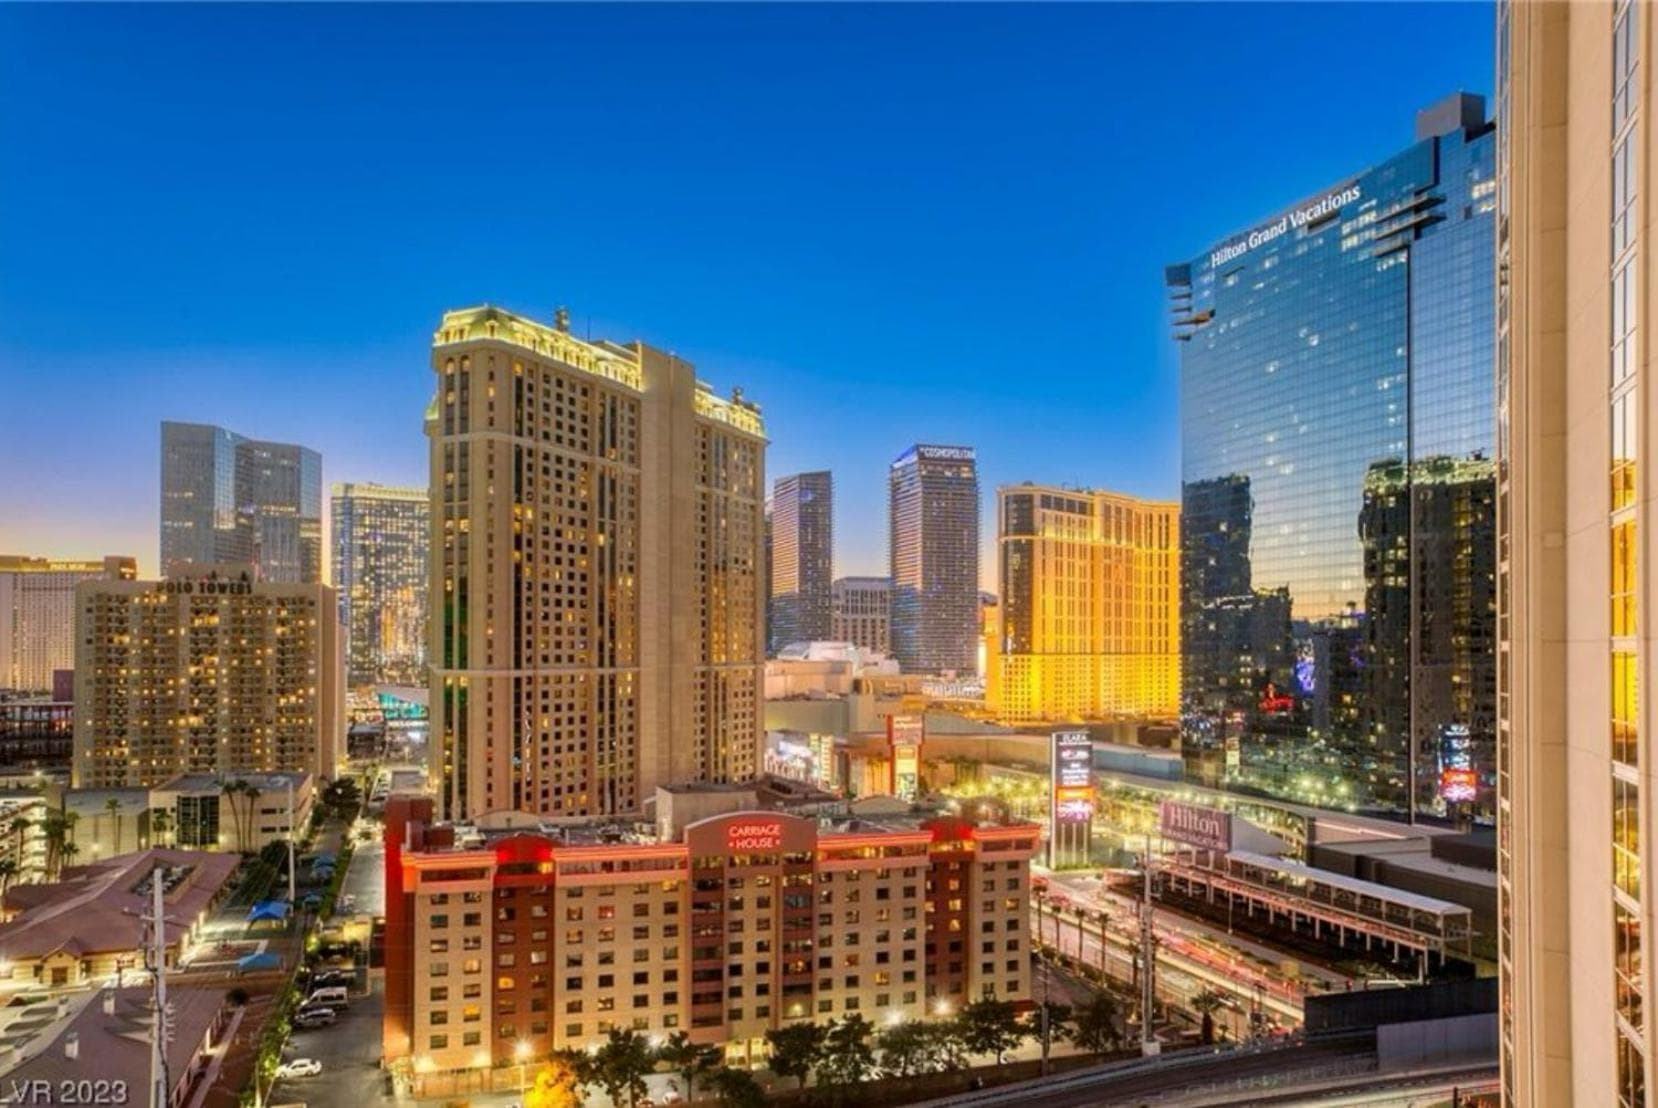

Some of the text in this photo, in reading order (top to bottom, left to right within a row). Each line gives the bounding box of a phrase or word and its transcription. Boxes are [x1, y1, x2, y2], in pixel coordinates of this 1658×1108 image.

[1211, 185, 1361, 268] Hilton Grand Vacations
[157, 582, 252, 594] POLO TOWERS
[1169, 805, 1220, 836] Hilton
[728, 824, 781, 838] CARRIAGE
[735, 837, 774, 849] HOUSE
